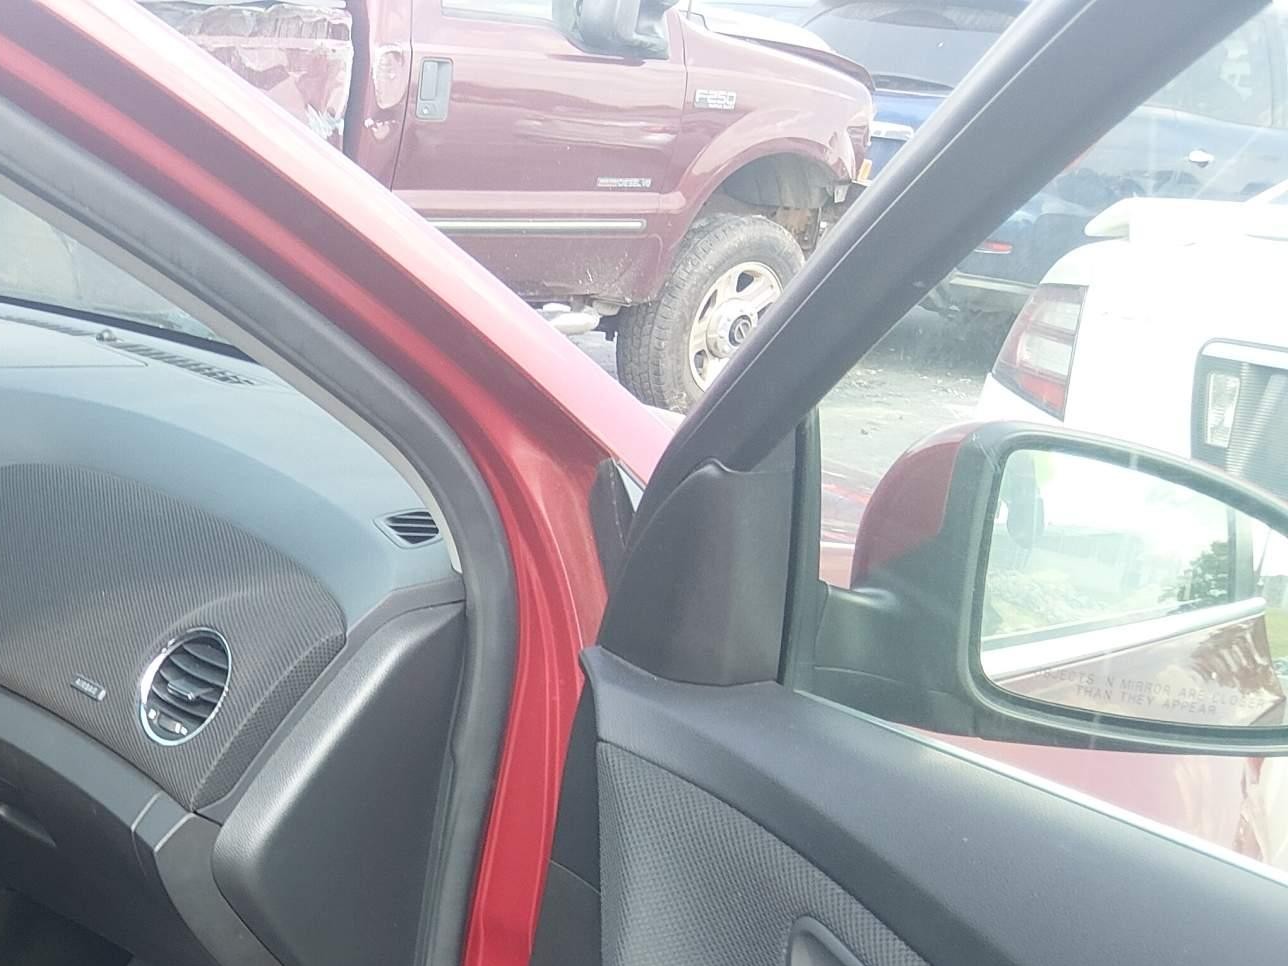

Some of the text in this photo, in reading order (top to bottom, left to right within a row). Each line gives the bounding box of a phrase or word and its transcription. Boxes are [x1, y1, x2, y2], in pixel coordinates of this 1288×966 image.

[1075, 684, 1217, 714] THAN THEY APPEAR
[1119, 679, 1171, 696] MIRROR
[1177, 687, 1206, 701] ARE
